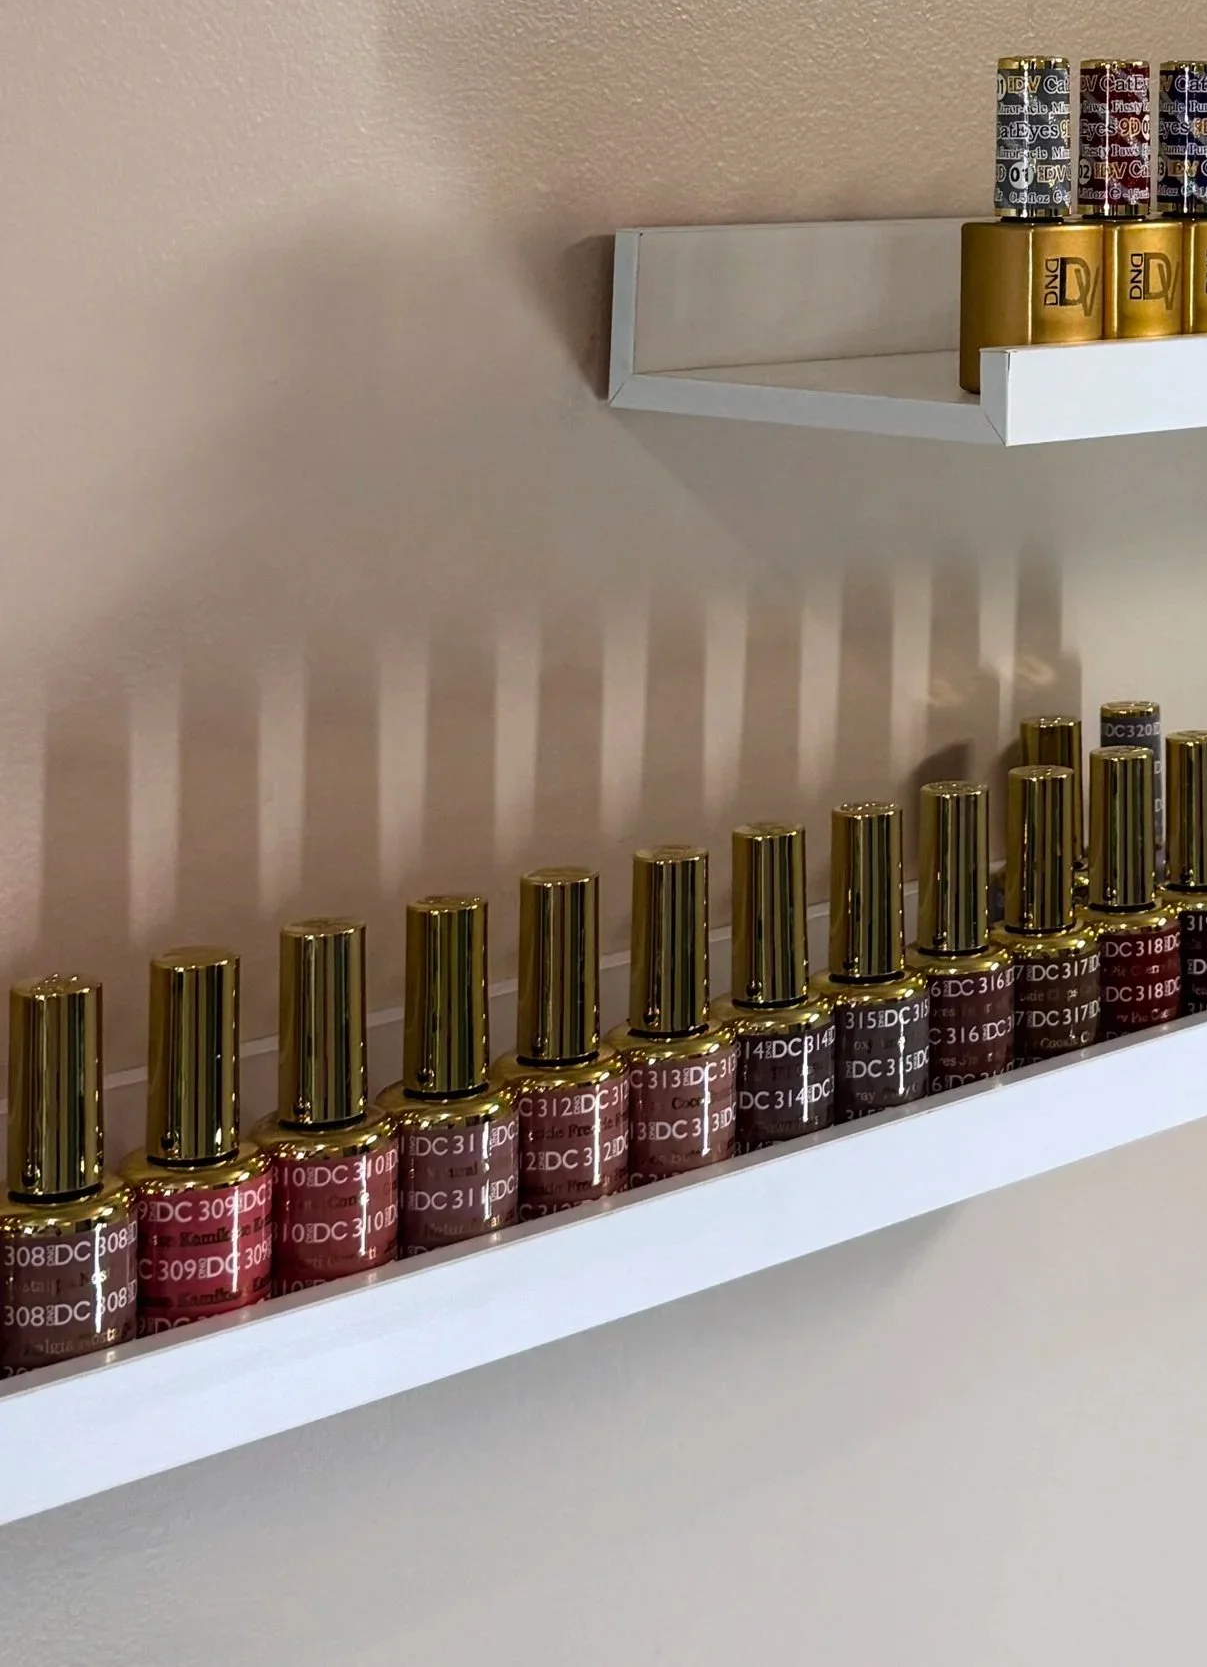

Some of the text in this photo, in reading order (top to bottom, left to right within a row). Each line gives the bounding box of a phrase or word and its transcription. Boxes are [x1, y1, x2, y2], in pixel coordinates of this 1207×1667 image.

[1106, 938, 1163, 957] DC 318
[1033, 960, 1087, 980] DC 317
[950, 977, 974, 996] DC
[1106, 982, 1163, 1003] DC 318
[845, 1010, 876, 1030] 315
[1033, 1004, 1087, 1026] DC 317
[947, 1024, 979, 1042] 316
[772, 1037, 801, 1057] DC
[852, 1057, 882, 1077] DC
[647, 1069, 680, 1089] 313
[739, 1090, 770, 1111] DC
[656, 1121, 688, 1140] DC
[416, 1135, 449, 1155] DC
[545, 1149, 580, 1169] DC
[315, 1164, 348, 1186] DC
[156, 1202, 192, 1222] DC
[200, 1198, 233, 1221] 309
[415, 1190, 449, 1211] DC
[314, 1221, 348, 1243] DC
[4, 1245, 44, 1265] 308
[55, 1241, 91, 1265] DC
[158, 1256, 240, 1282] 309 DC
[4, 1304, 44, 1326] 308
[55, 1300, 91, 1325] DC
